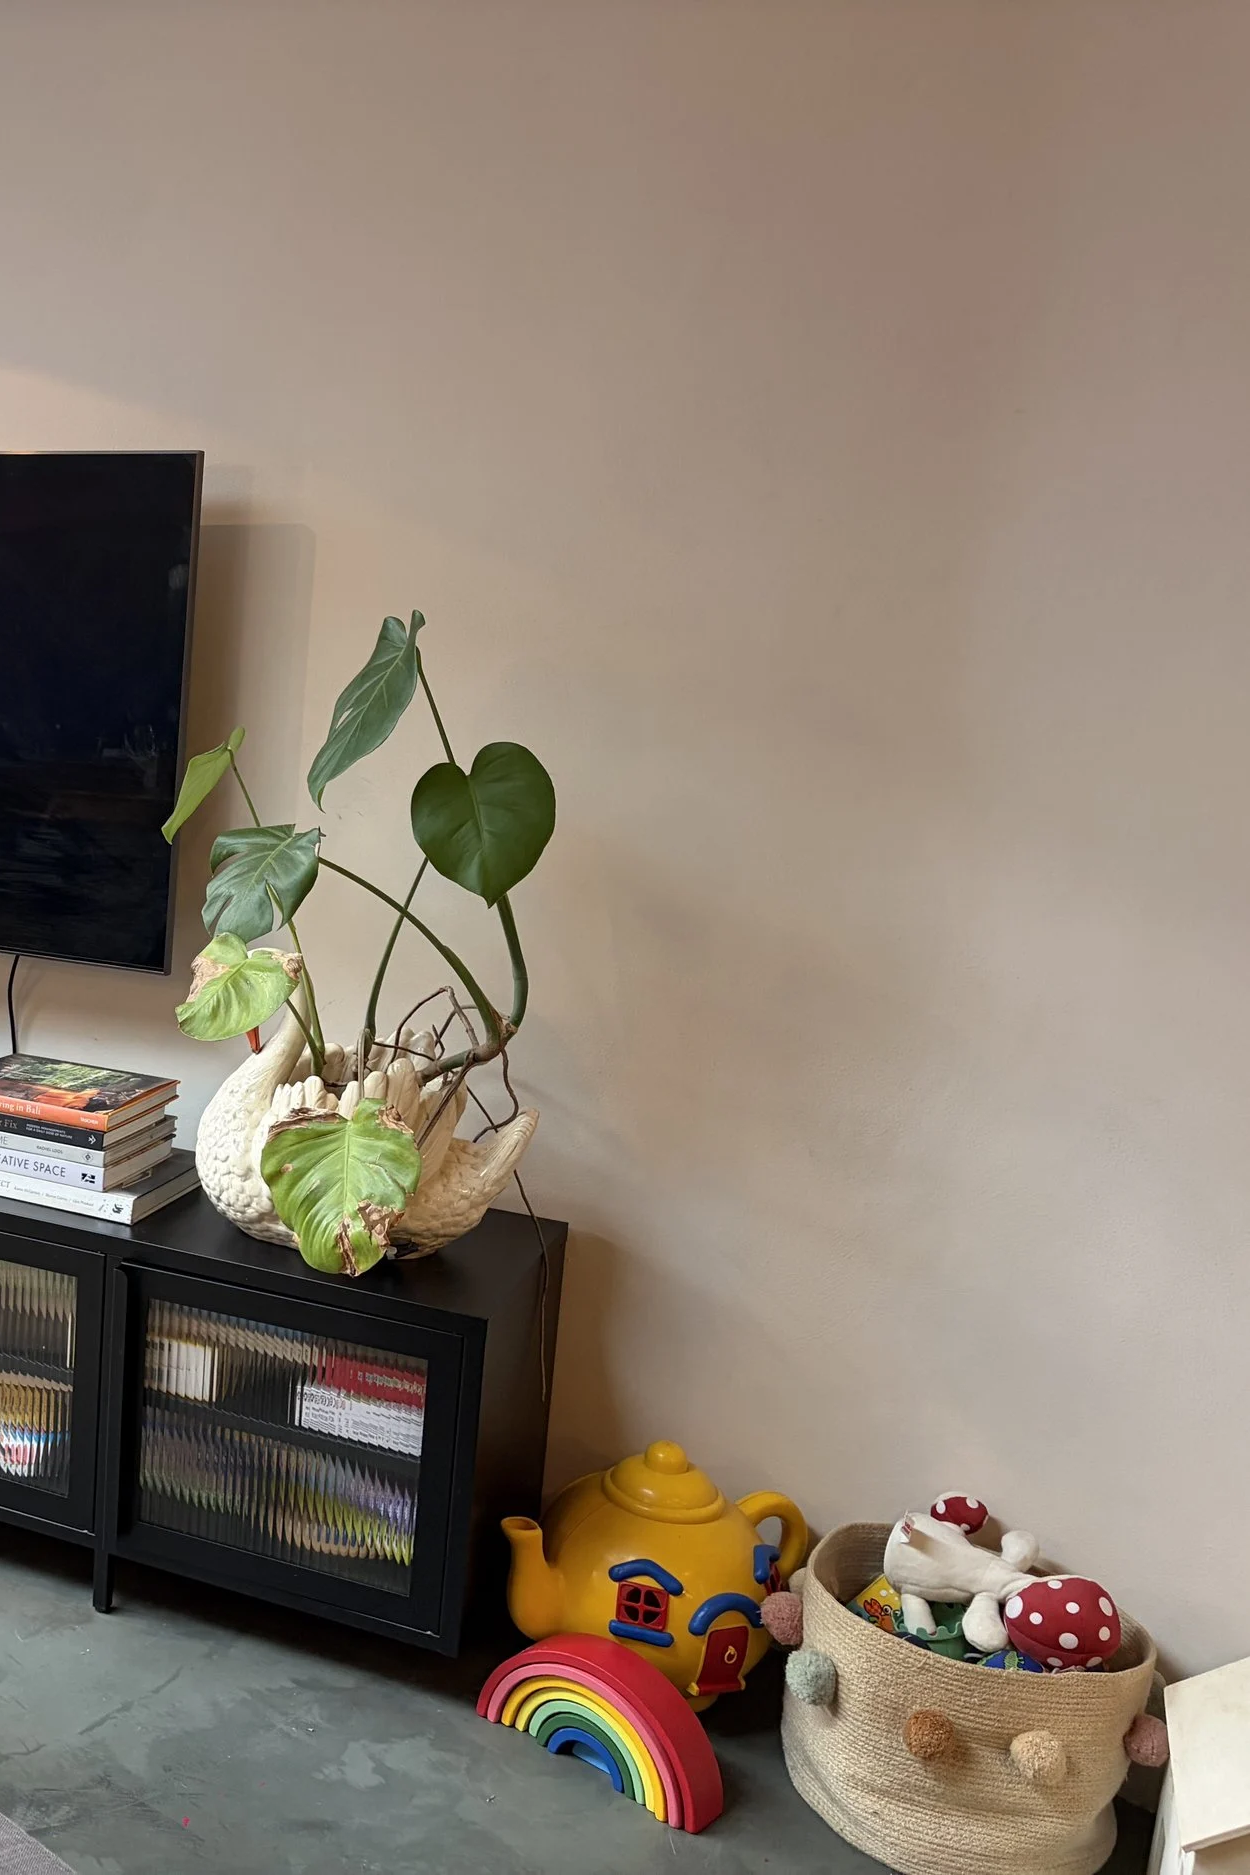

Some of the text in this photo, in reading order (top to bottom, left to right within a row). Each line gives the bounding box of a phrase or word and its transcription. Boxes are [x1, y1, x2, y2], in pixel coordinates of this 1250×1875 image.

[15, 1102, 24, 1112] in
[25, 1103, 41, 1115] Bali
[3, 1118, 18, 1130] Fix
[33, 1161, 67, 1178] SPACE
